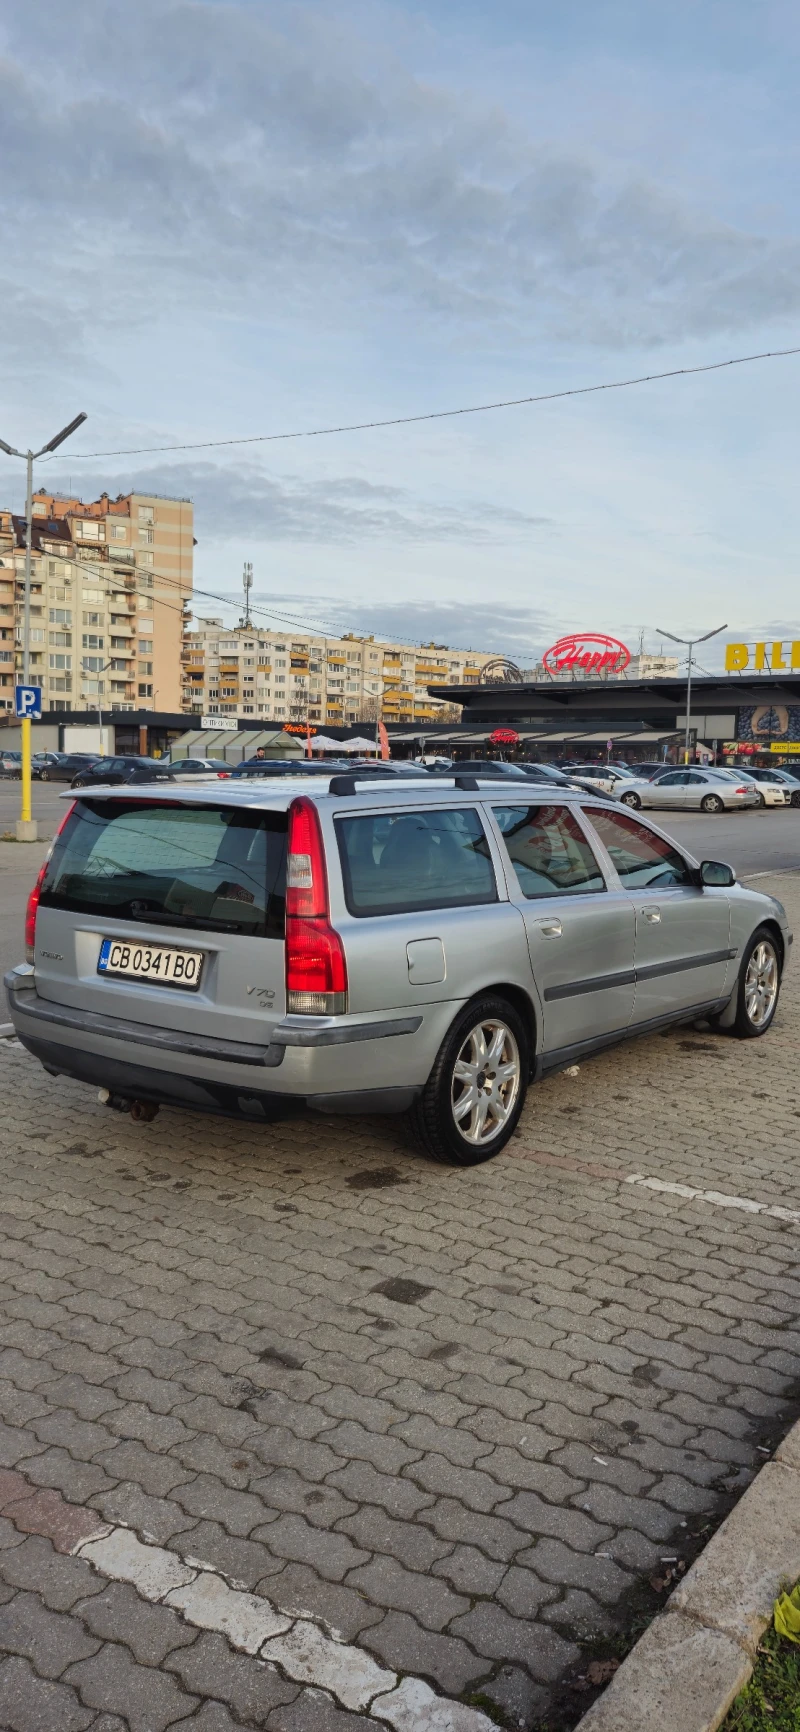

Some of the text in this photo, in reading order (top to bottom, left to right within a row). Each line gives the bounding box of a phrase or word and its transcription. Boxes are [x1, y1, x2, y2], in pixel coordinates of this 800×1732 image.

[552, 643, 623, 674] Happy
[21, 690, 36, 713] P
[110, 946, 196, 979] CB 0341 BO
[246, 984, 276, 999] V70
